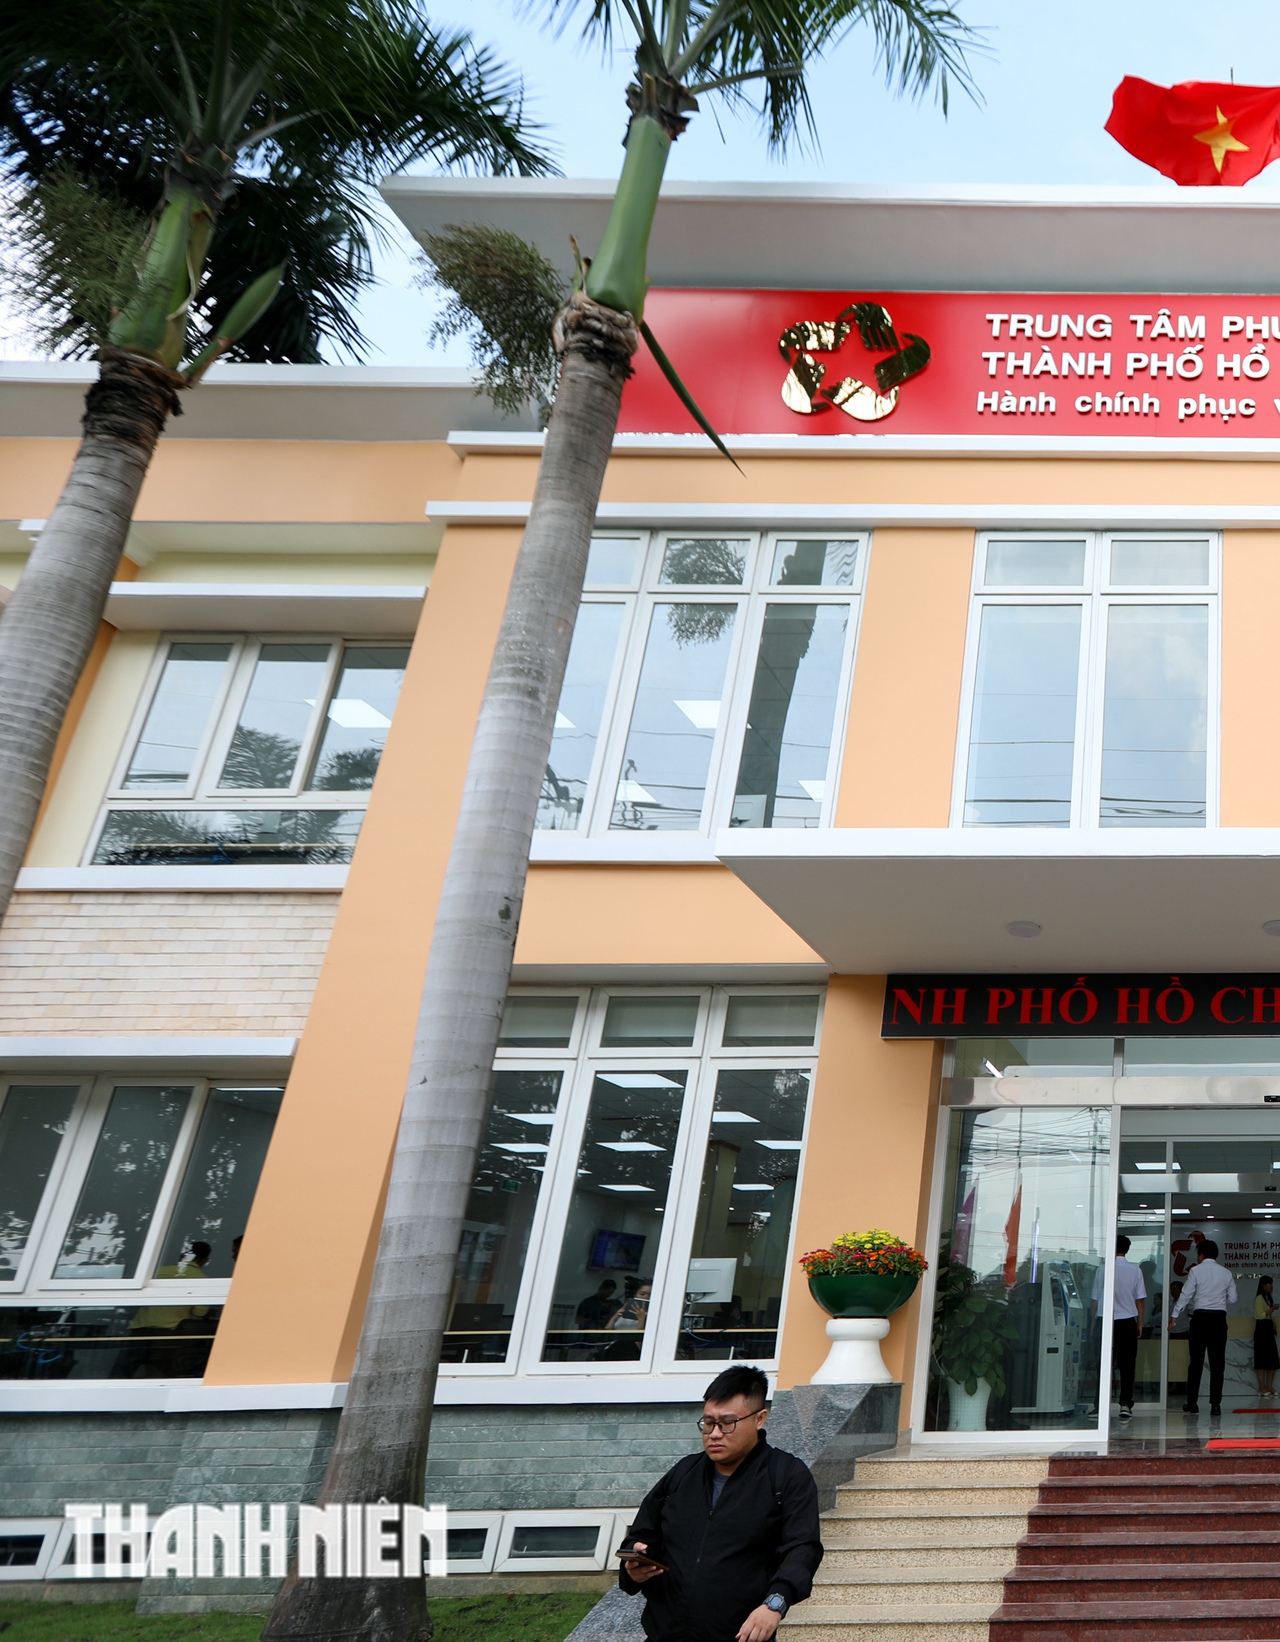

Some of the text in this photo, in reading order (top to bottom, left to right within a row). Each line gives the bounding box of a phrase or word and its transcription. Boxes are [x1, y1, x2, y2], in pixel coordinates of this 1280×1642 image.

[985, 313, 1113, 339] TRUNG
[1129, 308, 1206, 340] TÂM
[981, 344, 1112, 377] THÀNH
[1126, 343, 1204, 379] PHỐ
[1216, 342, 1270, 379] HỒ
[976, 389, 1056, 413] Hành
[1074, 391, 1160, 414] chính
[1177, 393, 1256, 421] phục
[882, 988, 969, 1025] NH
[984, 977, 1098, 1025] PHỐ
[1114, 976, 1195, 1024] HỒ
[1224, 1242, 1250, 1250] TRUNG
[1252, 1241, 1267, 1250] TÂM
[1224, 1252, 1250, 1260] THÀNH
